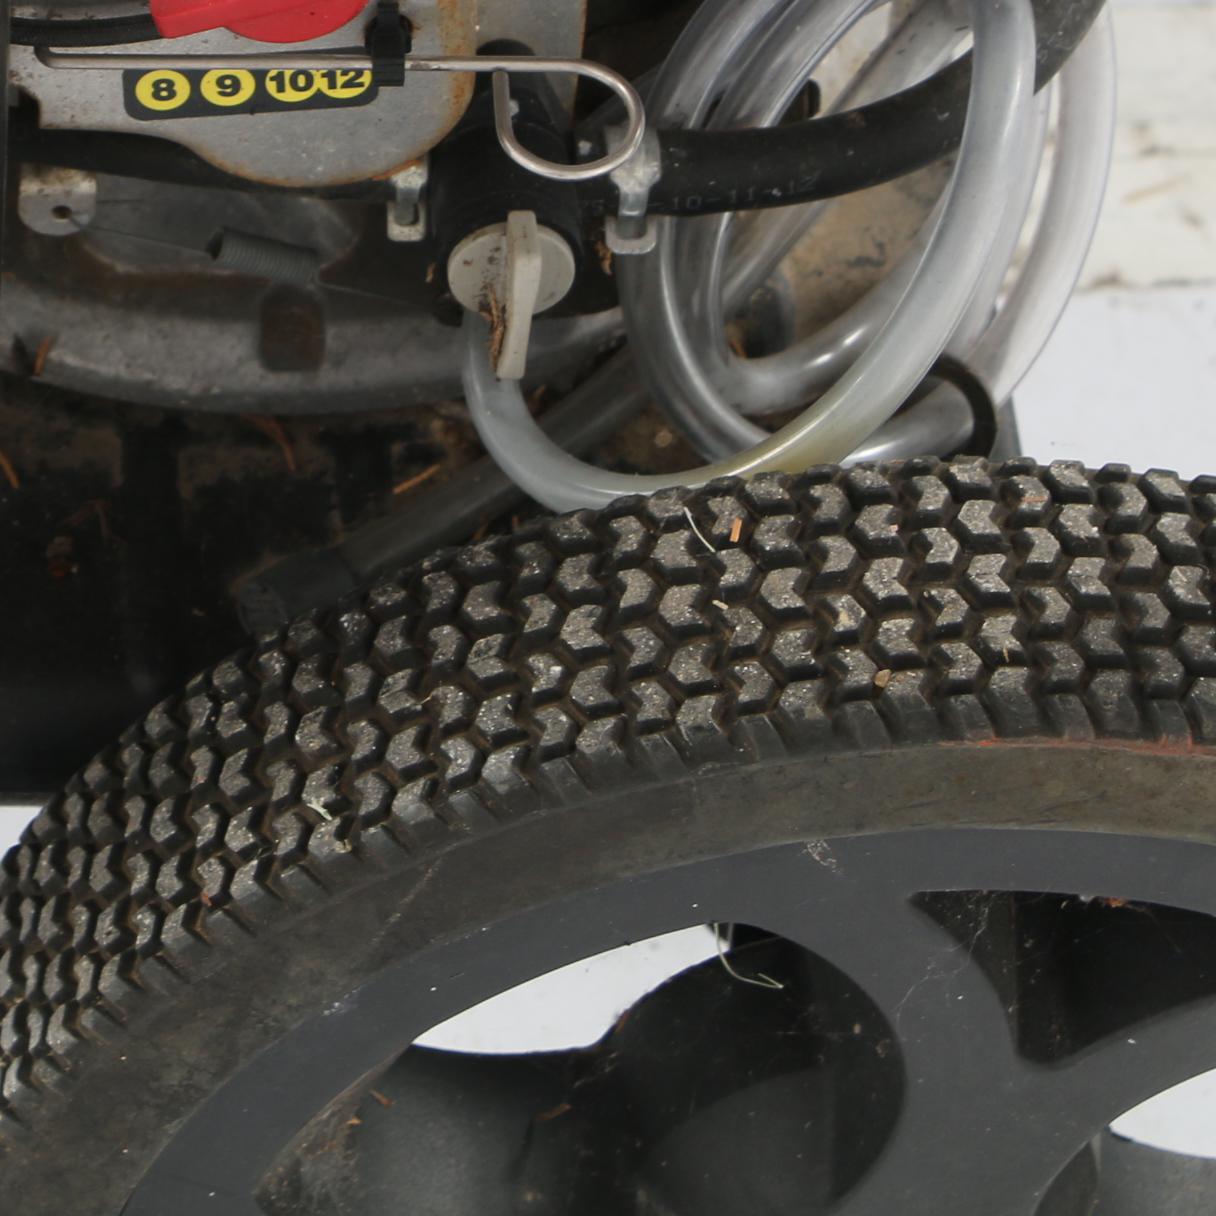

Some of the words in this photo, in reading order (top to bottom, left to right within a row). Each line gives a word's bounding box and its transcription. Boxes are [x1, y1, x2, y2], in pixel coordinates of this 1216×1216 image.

[151, 79, 178, 102] 8
[215, 74, 242, 97] 9
[269, 70, 315, 93] 10
[319, 69, 365, 89] 12
